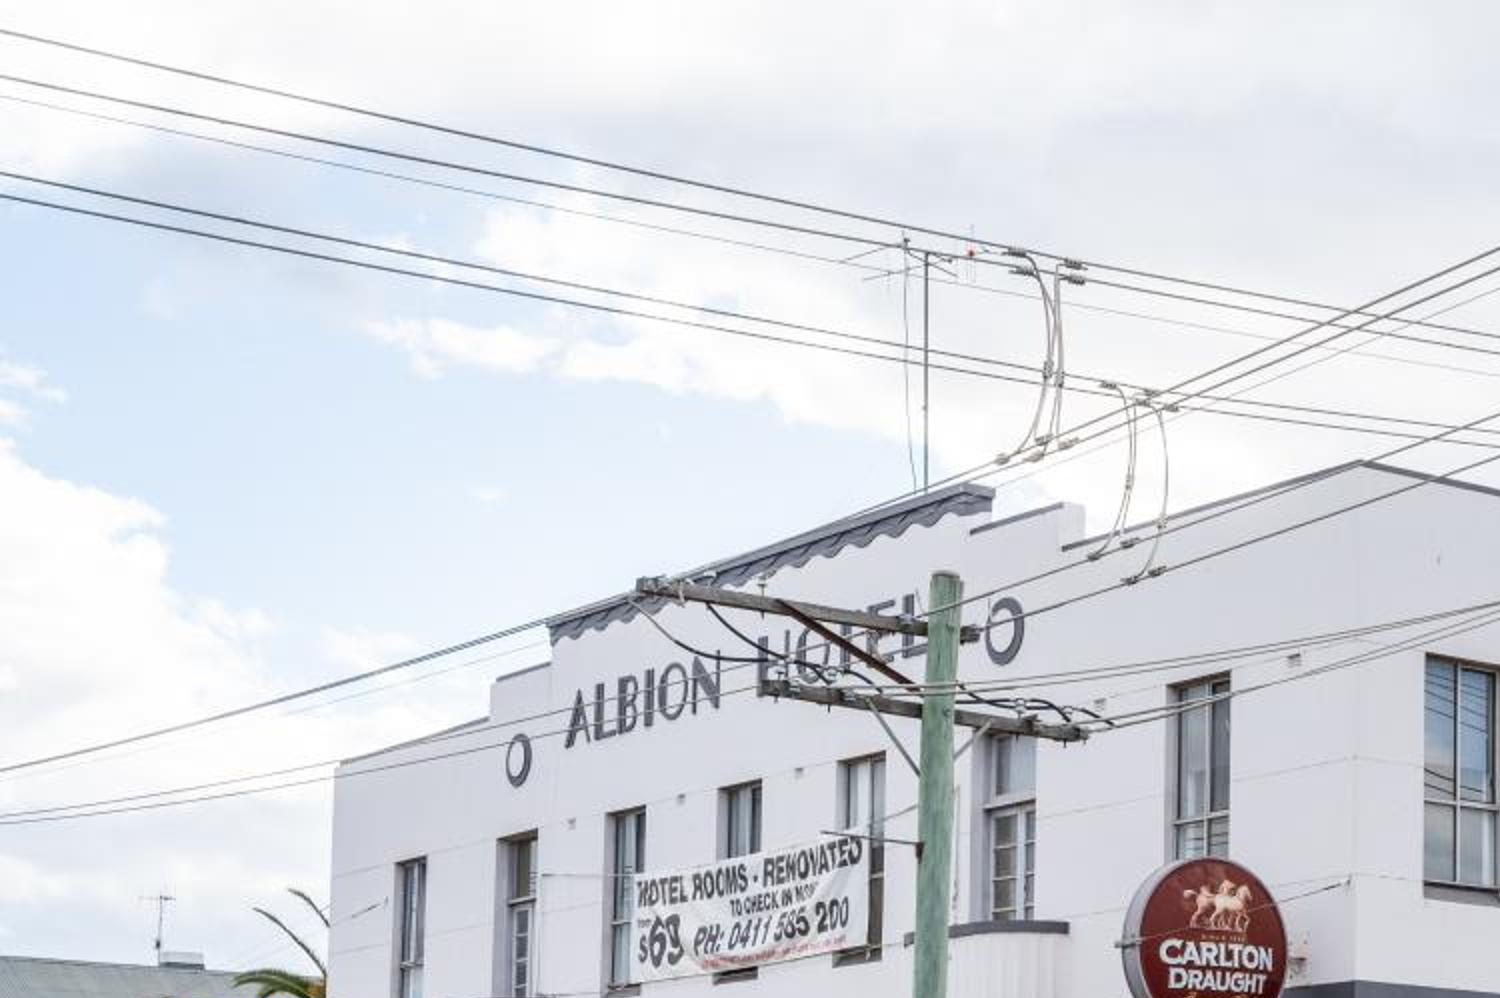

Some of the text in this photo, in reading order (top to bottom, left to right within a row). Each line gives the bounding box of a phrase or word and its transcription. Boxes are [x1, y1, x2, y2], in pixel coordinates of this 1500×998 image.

[564, 649, 721, 749] ALBION
[638, 875, 688, 907] HOTEL
[692, 863, 748, 901] ROOMS
[763, 836, 863, 887] RENOVATED
[694, 920, 725, 956] PH:
[728, 915, 772, 951] 0411
[816, 896, 849, 934] 200
[730, 900, 743, 917] TO
[744, 893, 779, 913] CHECK
[781, 889, 793, 907] IN
[1159, 937, 1273, 972] CARLTON
[1168, 966, 1267, 995] DRAUGHT
